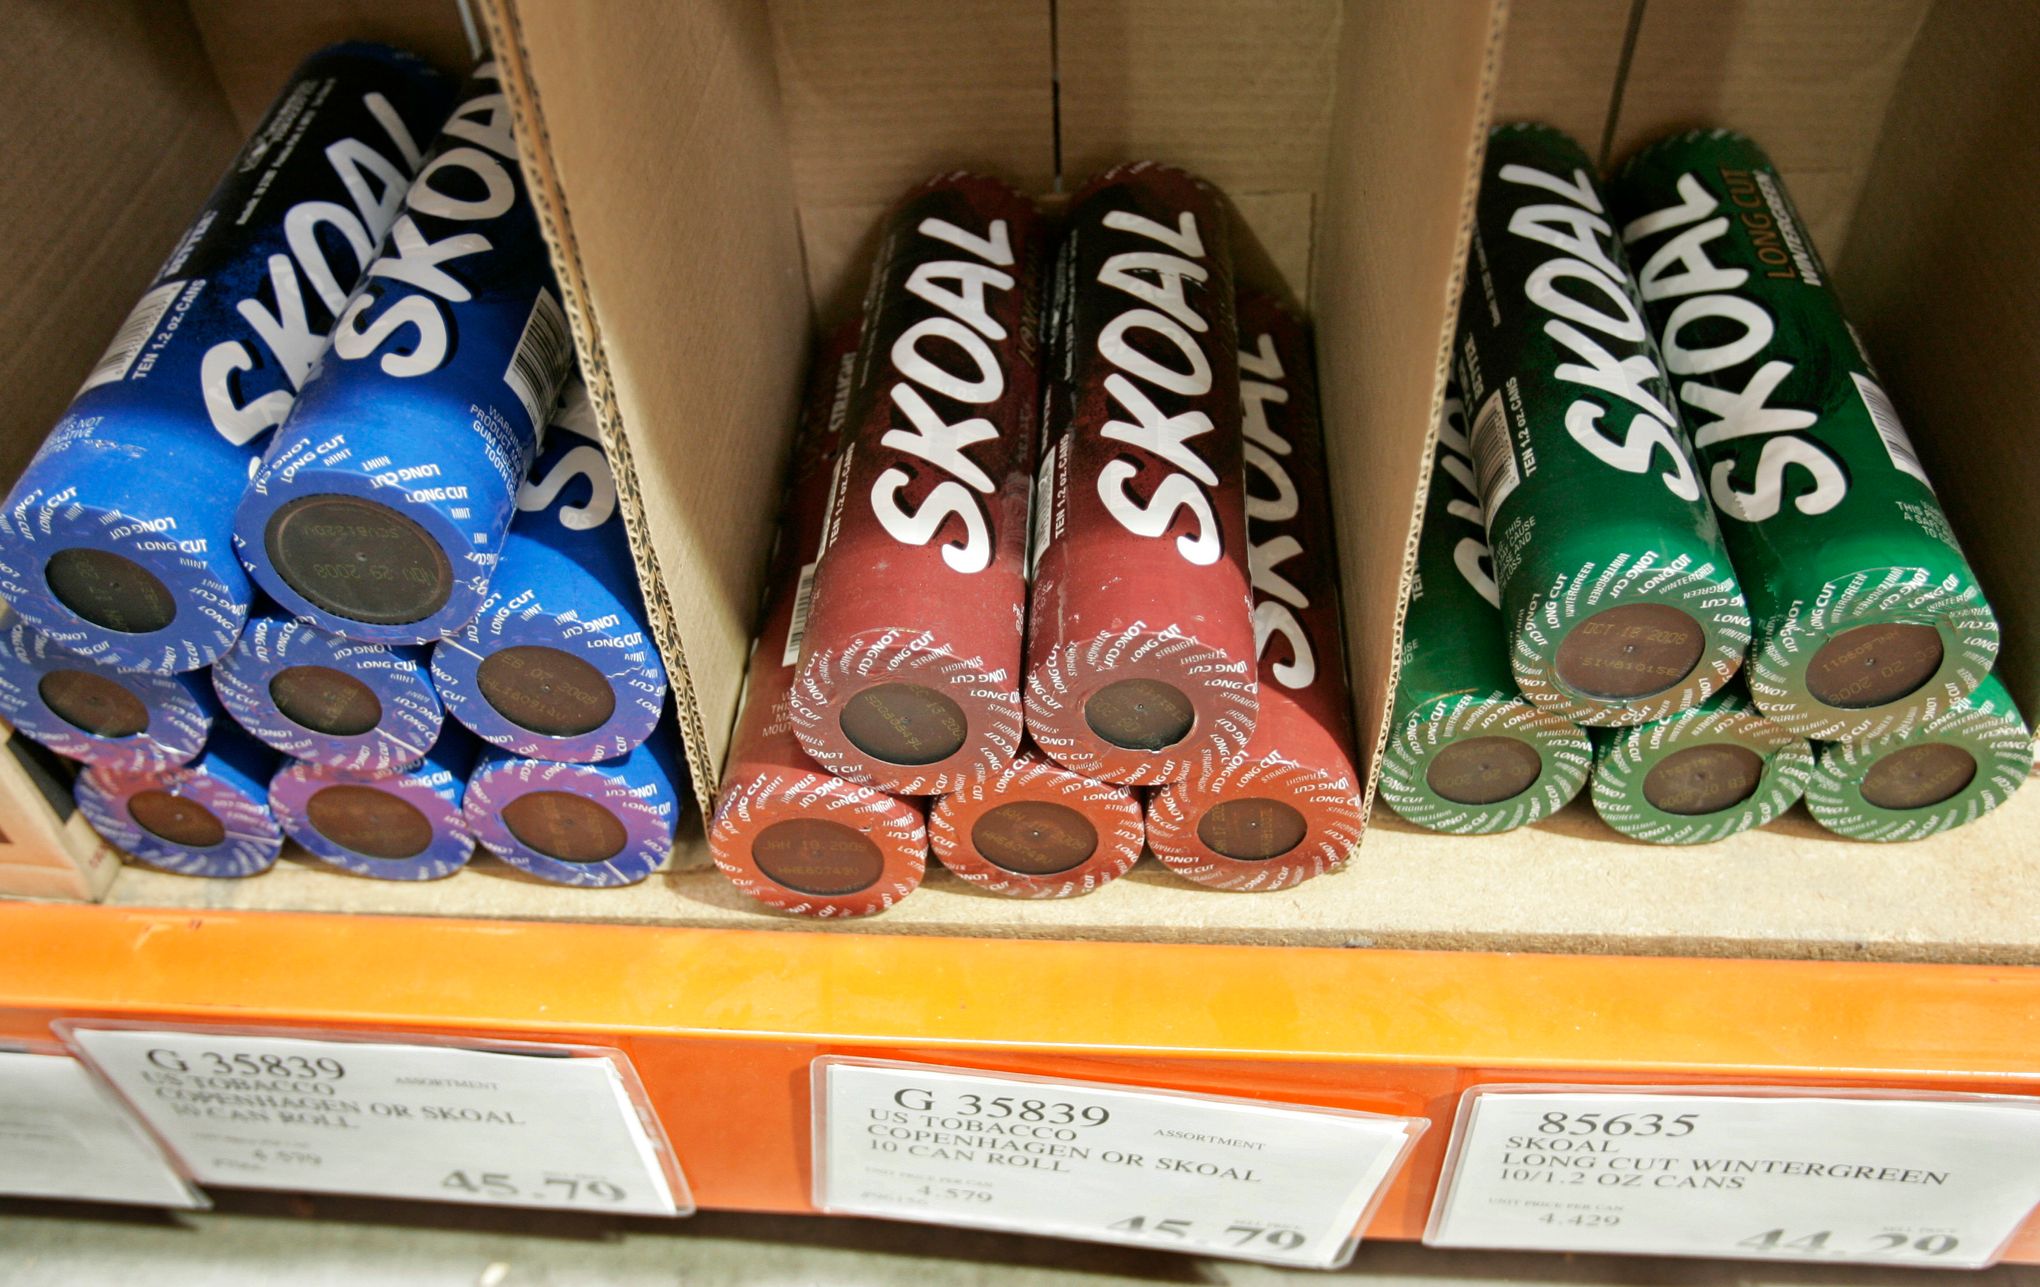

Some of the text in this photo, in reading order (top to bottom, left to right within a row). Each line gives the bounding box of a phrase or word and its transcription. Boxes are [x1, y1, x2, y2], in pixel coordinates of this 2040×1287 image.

[1721, 168, 1796, 279] LONG CUT
[201, 92, 428, 482] SKOAL
[132, 348, 158, 380] TEN
[152, 328, 173, 351] 1.2
[175, 279, 207, 312] CANS
[1499, 163, 1699, 502] SKOAL
[1622, 172, 1848, 523] SKOAL
[871, 217, 1015, 574] SKOAL
[1097, 210, 1222, 566] SKOAL
[1506, 376, 1522, 411] CANS
[470, 404, 511, 450] PRODUCT
[473, 420, 496, 447] GUM
[1517, 428, 1531, 448] 1.2
[281, 434, 346, 484] LONG CUT
[323, 448, 352, 467] MINT
[484, 443, 508, 482] TOOTH
[1058, 433, 1070, 467] CANS
[1522, 453, 1537, 477] TEN
[406, 486, 468, 503] LONG CUT
[1057, 486, 1067, 506] 1.2
[109, 516, 177, 541] LONG CUT
[451, 508, 471, 520] MINT
[1055, 508, 1066, 539] TEN
[1504, 516, 1522, 538] THIS
[136, 539, 208, 553] LONG CUT
[829, 518, 842, 547] TEN
[1508, 516, 1536, 546] CAUSE
[1515, 532, 1532, 554] AND
[1506, 556, 1522, 580] LOSS
[1610, 551, 1659, 598] LONG CUT
[1638, 554, 1692, 594] LONG CUT
[491, 589, 536, 635] LONG CUT
[1545, 573, 1568, 630] LONG CUT
[1810, 582, 1836, 630] LONG CUT
[587, 632, 642, 649] LONG CUT
[1102, 620, 1148, 668] LONG CUT
[1130, 623, 1181, 662] LONG CUT
[1583, 622, 1615, 636] OCT
[856, 629, 901, 677] LONG CUT
[887, 630, 935, 671] LONG CUT
[1155, 636, 1199, 660] STRAIGHT
[803, 650, 828, 706] LONG CUT
[950, 674, 975, 684] CUT
[1045, 643, 1068, 694] LONG CUT
[1204, 678, 1243, 690] LONG
[970, 689, 1008, 701] LONG
[1044, 694, 1063, 711] CUT
[994, 751, 1034, 793] LONG CUT
[1211, 750, 1249, 794] LONG CUT
[1236, 750, 1282, 788] LONG CUT
[737, 772, 768, 823] LONG CUT
[147, 1049, 345, 1079] G 35839
[188, 1075, 335, 1096] TOBACCO
[156, 1086, 526, 1125] COPENHAGEN OR SKOAL
[206, 1107, 271, 1122] CAN
[279, 1111, 360, 1129] ROLL
[894, 1088, 1110, 1127] G 35839
[869, 1108, 1078, 1142] US TOBACCO
[1153, 1128, 1267, 1151] ASSORTMENT
[1538, 1111, 1700, 1137] 85635
[868, 1124, 1262, 1183] COPENHAGEN OR SKOAL
[870, 1139, 1072, 1173] 10 CAN ROLL
[1505, 1136, 1620, 1153] SKOAL
[440, 1169, 627, 1202] 45.79
[1500, 1168, 1746, 1189] 10/1.2 OZ CANS
[1502, 1153, 1950, 1185] LONG CUT WINTERGREEN
[916, 1185, 993, 1203] 4.579
[1538, 1212, 1621, 1227] 4.429
